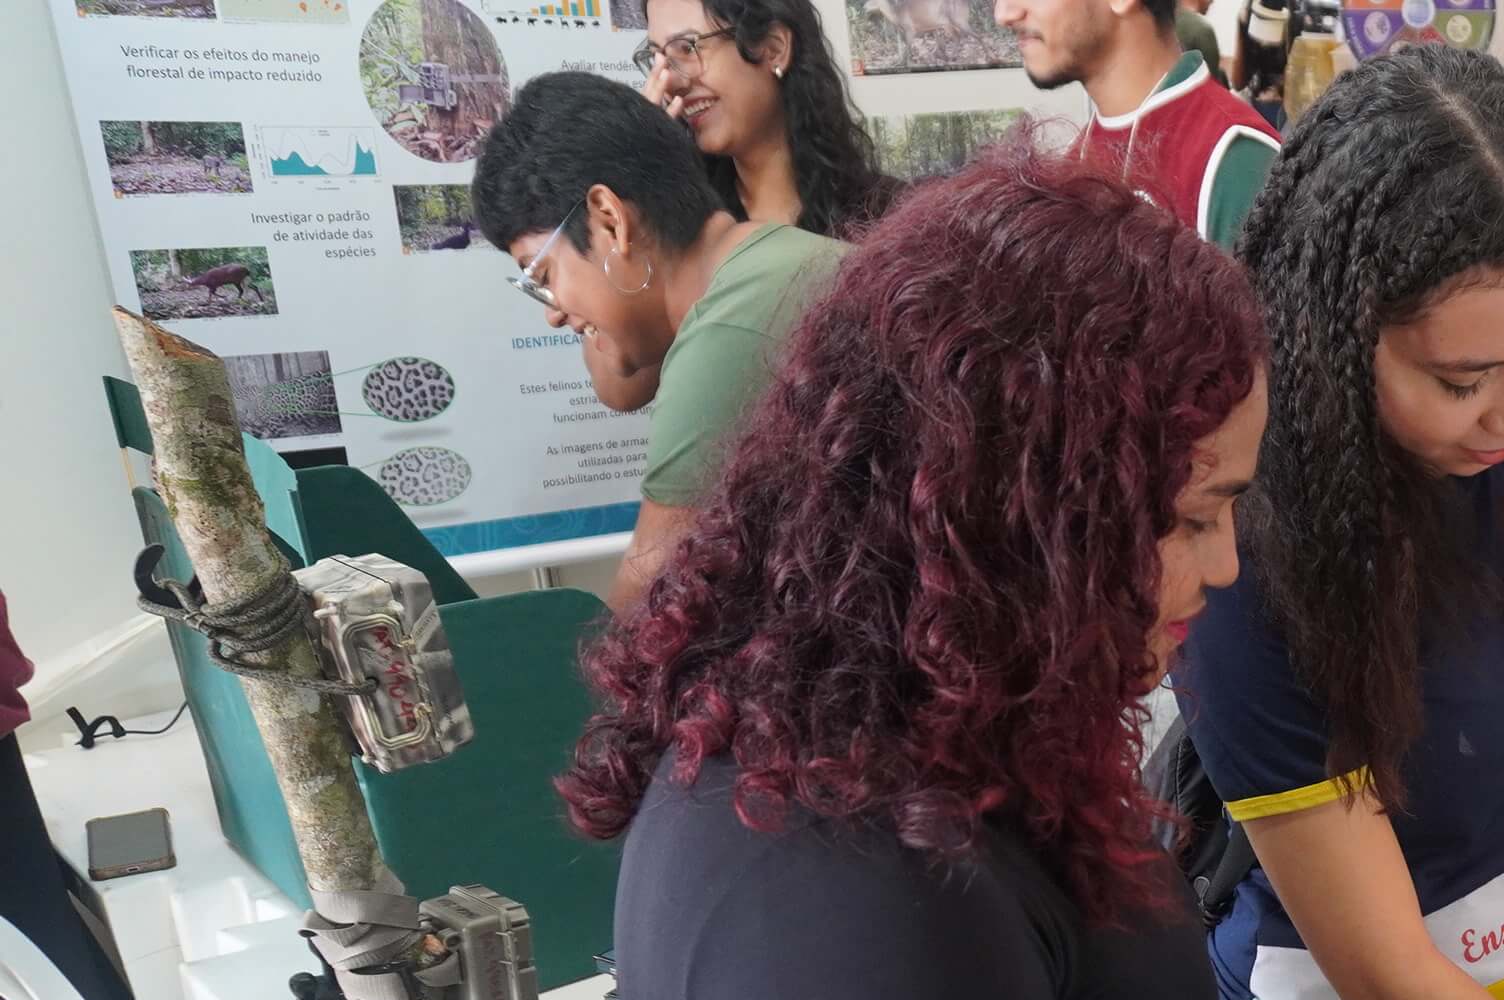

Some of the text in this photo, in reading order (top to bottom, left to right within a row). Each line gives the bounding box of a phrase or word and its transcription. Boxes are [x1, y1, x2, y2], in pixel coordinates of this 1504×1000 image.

[120, 44, 320, 65] Verificar os efeitos do manejo
[127, 65, 322, 82] florestal de impacto reduzido
[251, 210, 370, 225] Investigar o padrão
[273, 228, 373, 242] de atividade das
[325, 246, 376, 259] espécies
[520, 383, 546, 394] Estes
[549, 381, 582, 392] felinos
[553, 410, 607, 423] funcionam
[546, 446, 558, 455] As
[562, 443, 603, 455] imagens
[606, 439, 618, 449] de
[578, 453, 647, 468] utilizadas para
[543, 467, 644, 488] possibilitando o estu
